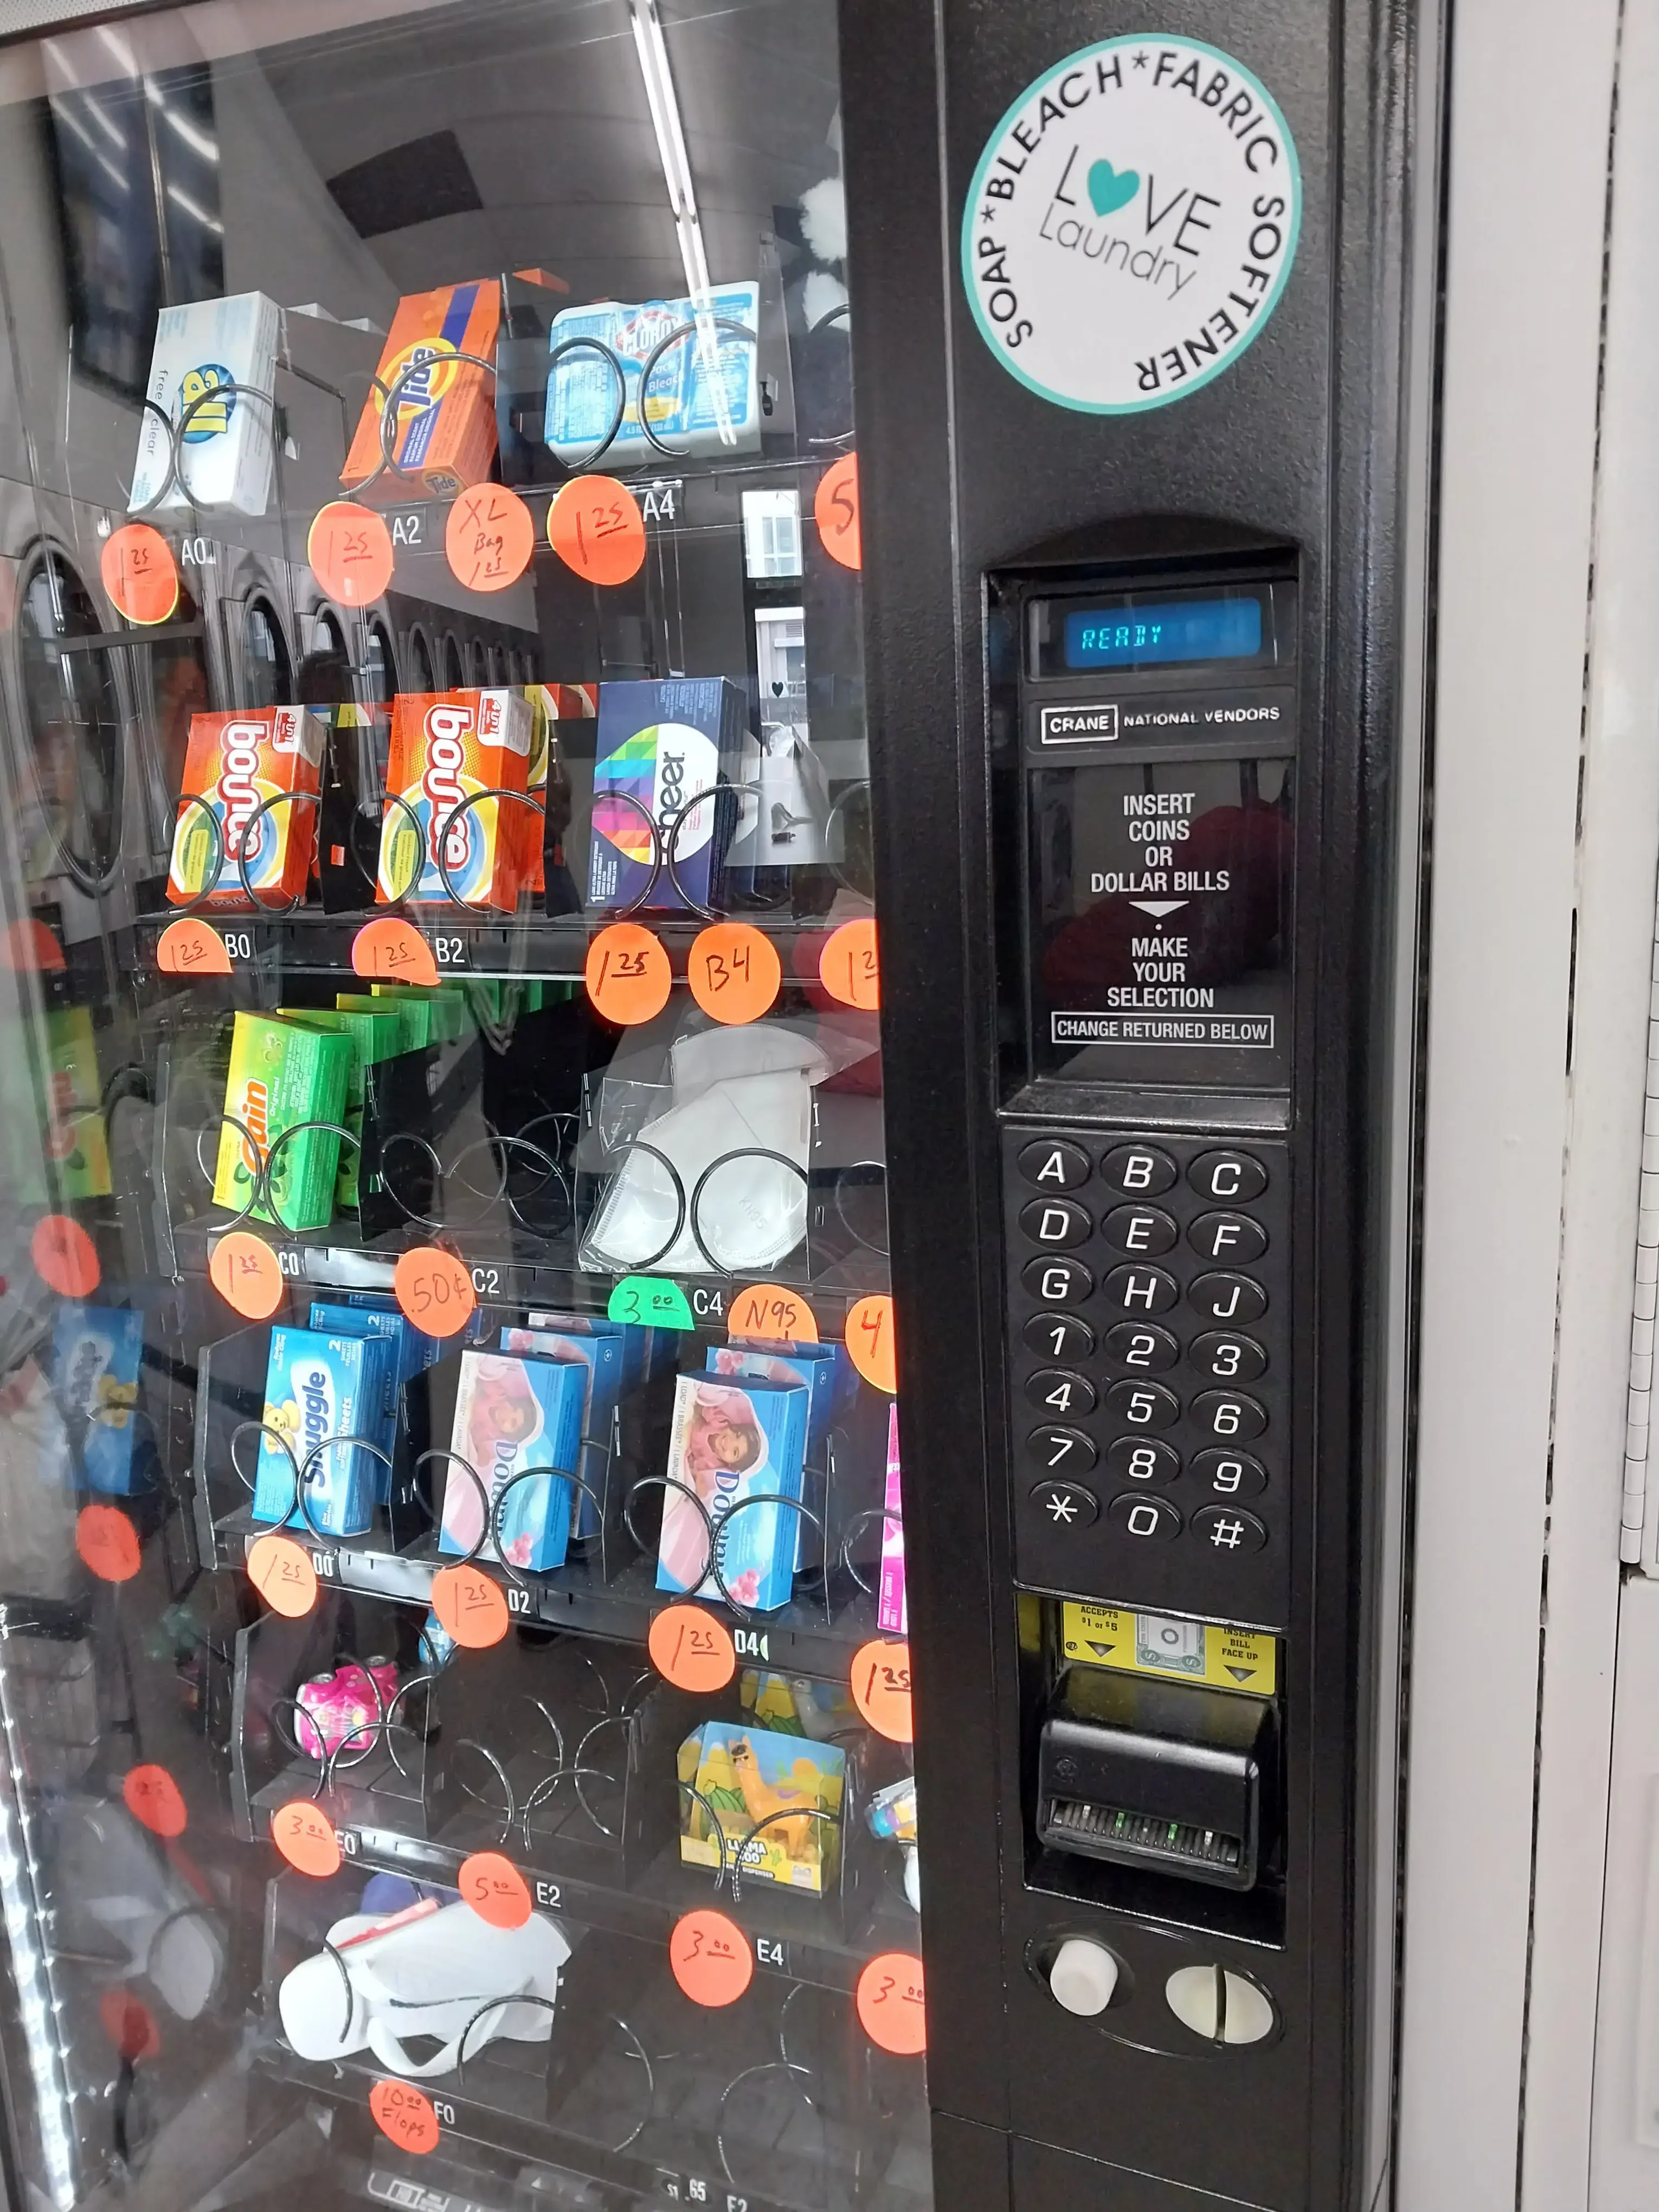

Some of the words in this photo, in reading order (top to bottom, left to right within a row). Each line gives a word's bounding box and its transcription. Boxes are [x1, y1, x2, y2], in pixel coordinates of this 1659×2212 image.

[986, 55, 1123, 201] BLEACH
[1039, 203, 1197, 300] Laundry
[978, 235, 1033, 348] SOAP
[1134, 194, 1285, 391] SOFTENER
[155, 369, 169, 400] free
[146, 419, 158, 455] clear
[426, 476, 456, 493] Tide
[459, 499, 507, 533] XL
[643, 490, 675, 522] A4
[393, 516, 421, 545] A2
[474, 535, 503, 555] Bag
[1082, 625, 1161, 650] READY
[1050, 716, 1109, 732] CRANE
[1124, 713, 1198, 727] NATIONAL
[1205, 708, 1279, 723] VENDORS
[1124, 793, 1195, 815] INSERT
[1129, 820, 1189, 842] COINS
[1145, 846, 1172, 866] OR
[1091, 873, 1167, 892] DOLLAR
[1174, 871, 1229, 891] BILLS
[436, 938, 465, 963] B2
[1131, 938, 1188, 957] MAKE
[706, 945, 750, 991] B4
[1133, 963, 1185, 982] YOUR
[1107, 987, 1213, 1008] SELECTION
[1057, 1021, 1118, 1037] CHANGE
[1123, 1023, 1205, 1039] RETURNED
[1210, 1024, 1267, 1040] BELOW
[269, 1077, 280, 1117] Original
[1038, 1152, 1065, 1184] A
[1123, 1156, 1154, 1188] B
[1211, 1163, 1241, 1195] C
[1040, 1209, 1069, 1240] D
[1126, 1219, 1154, 1249] E
[1212, 1225, 1240, 1255] F
[472, 1268, 499, 1294] C2
[1041, 1268, 1070, 1298] G
[1124, 1276, 1157, 1309] H
[693, 1289, 723, 1316] C4
[745, 1300, 797, 1328] N95
[1213, 1287, 1240, 1317] J
[368, 1315, 379, 1326] 2
[329, 1340, 341, 1352] 2
[1050, 1327, 1066, 1355] 1
[1126, 1335, 1155, 1366] 2
[1212, 1345, 1240, 1375] 3
[1045, 1384, 1071, 1411] 4
[1127, 1392, 1156, 1423] 5
[1213, 1404, 1241, 1434] 6
[1048, 1437, 1073, 1465] 7
[1129, 1449, 1156, 1478] 8
[1213, 1462, 1242, 1492] 9
[1128, 1506, 1158, 1536] 0
[1210, 1520, 1244, 1548] #
[1081, 1606, 1118, 1618] ACCEPTS
[1105, 1622, 1117, 1631] $5
[1224, 1628, 1256, 1638] INSERT
[1222, 1648, 1243, 1657] FACE
[1230, 1639, 1250, 1648] BILL
[537, 1883, 562, 1907] E2
[757, 1939, 783, 1965] E4
